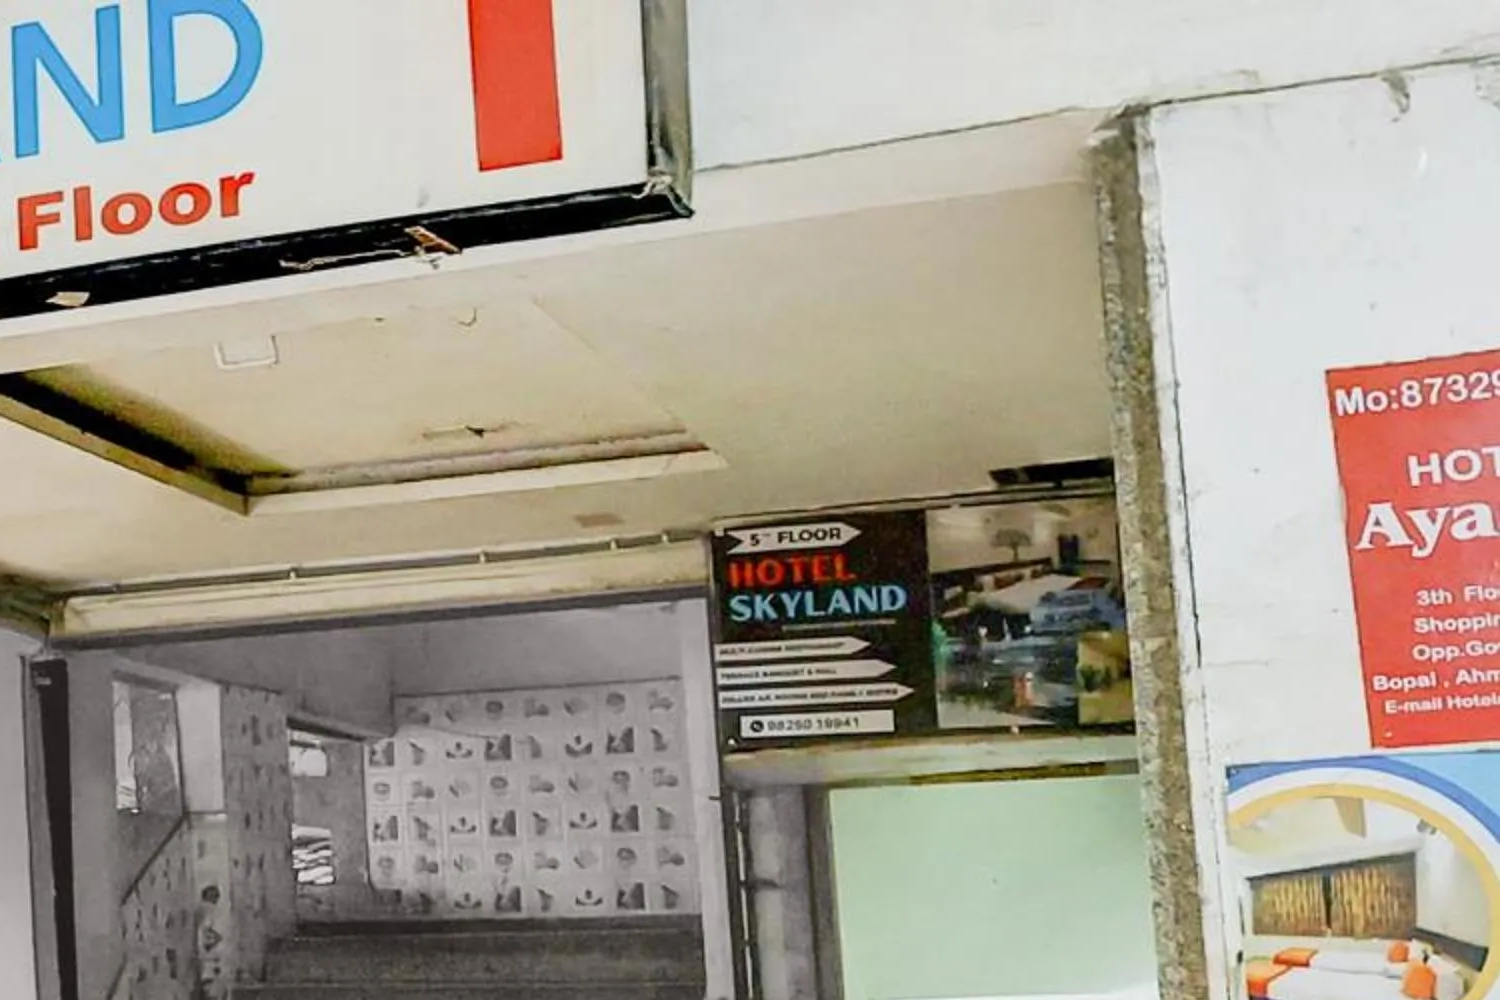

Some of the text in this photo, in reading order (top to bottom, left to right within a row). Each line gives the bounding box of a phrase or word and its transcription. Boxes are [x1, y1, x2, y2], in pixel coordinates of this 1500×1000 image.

[17, 170, 256, 251] Floor
[777, 527, 841, 545] FLOOR
[728, 553, 858, 589] HOTEL
[728, 584, 908, 622] SKYLAND
[1415, 589, 1453, 606] 3th
[1412, 640, 1500, 663] Opp.Go
[1372, 671, 1437, 694] Bopal
[1384, 696, 1443, 715] E-mail
